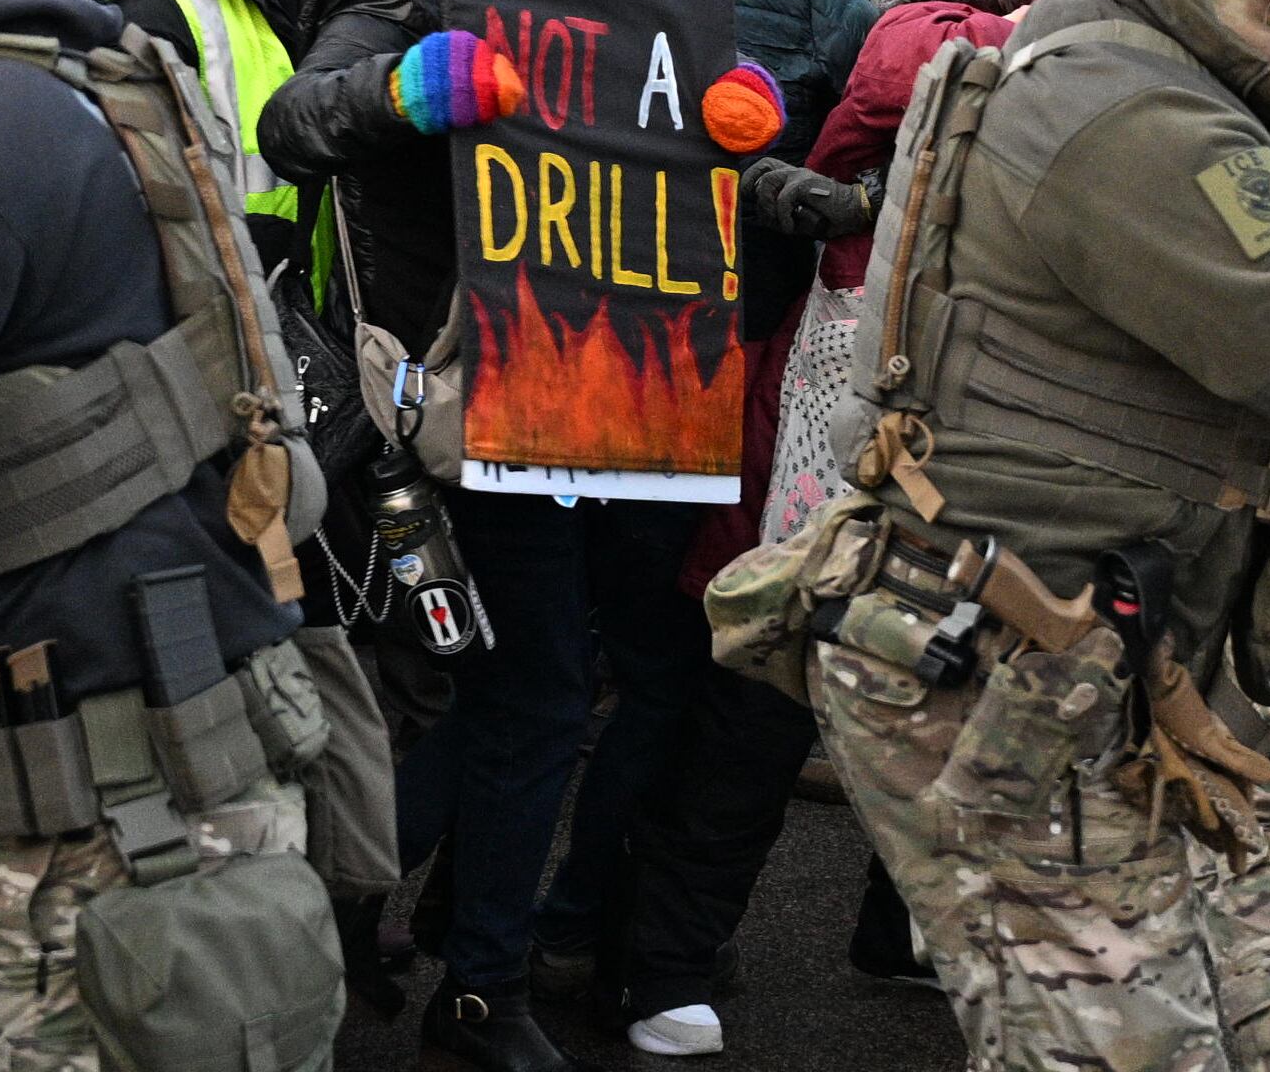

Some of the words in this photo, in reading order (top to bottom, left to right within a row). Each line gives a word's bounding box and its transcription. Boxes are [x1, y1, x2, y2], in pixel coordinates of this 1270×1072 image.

[484, 5, 609, 130] NOT
[638, 31, 684, 131] A
[474, 143, 740, 301] DRILL!
[1223, 150, 1264, 178] ICE
